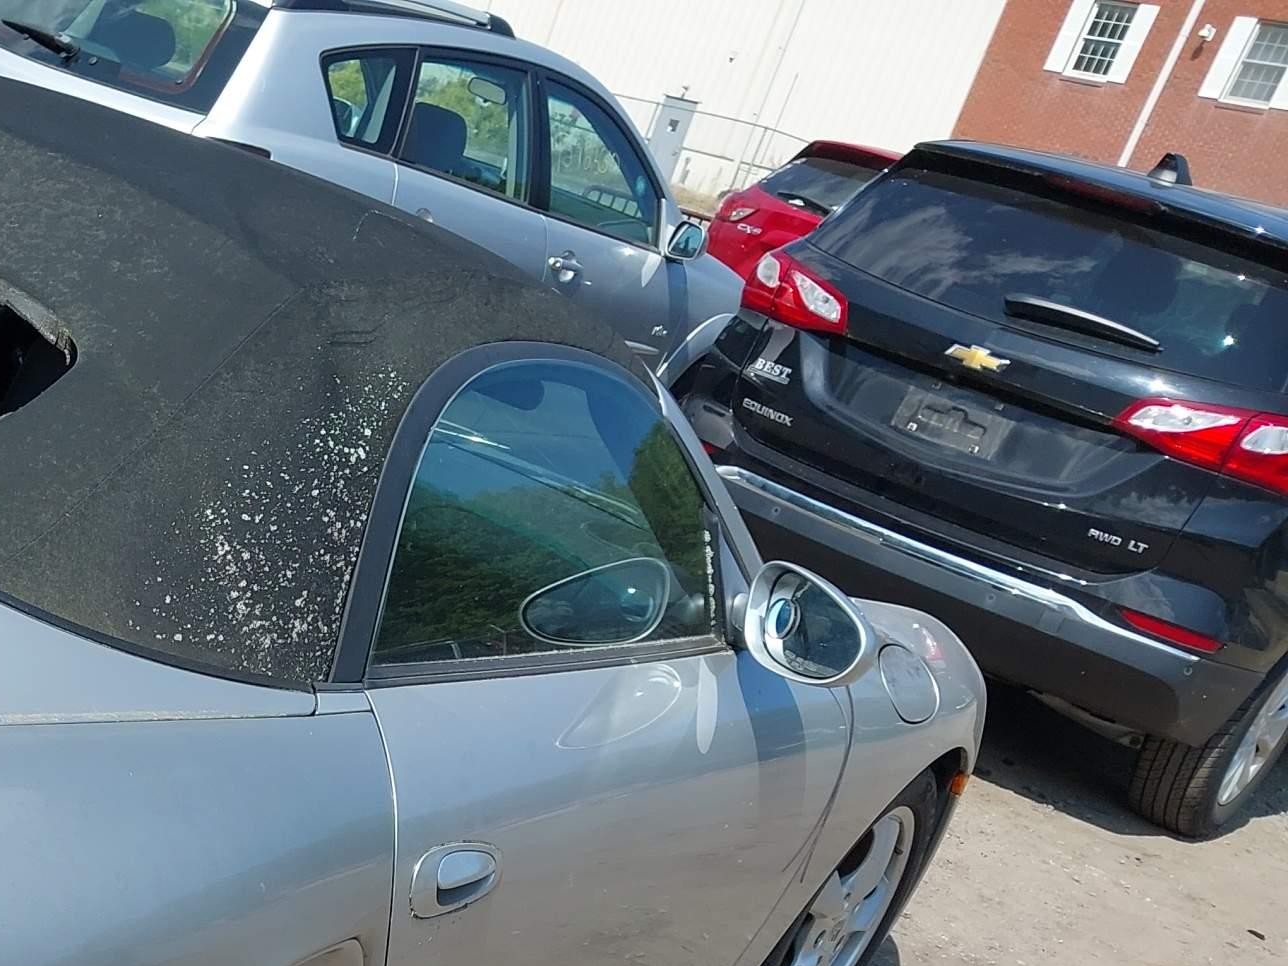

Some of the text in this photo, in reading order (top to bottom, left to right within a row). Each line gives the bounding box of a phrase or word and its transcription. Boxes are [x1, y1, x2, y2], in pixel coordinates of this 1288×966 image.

[755, 357, 792, 378] BEST
[743, 398, 793, 427] EQUINOX
[1088, 528, 1149, 554] AWD LT
